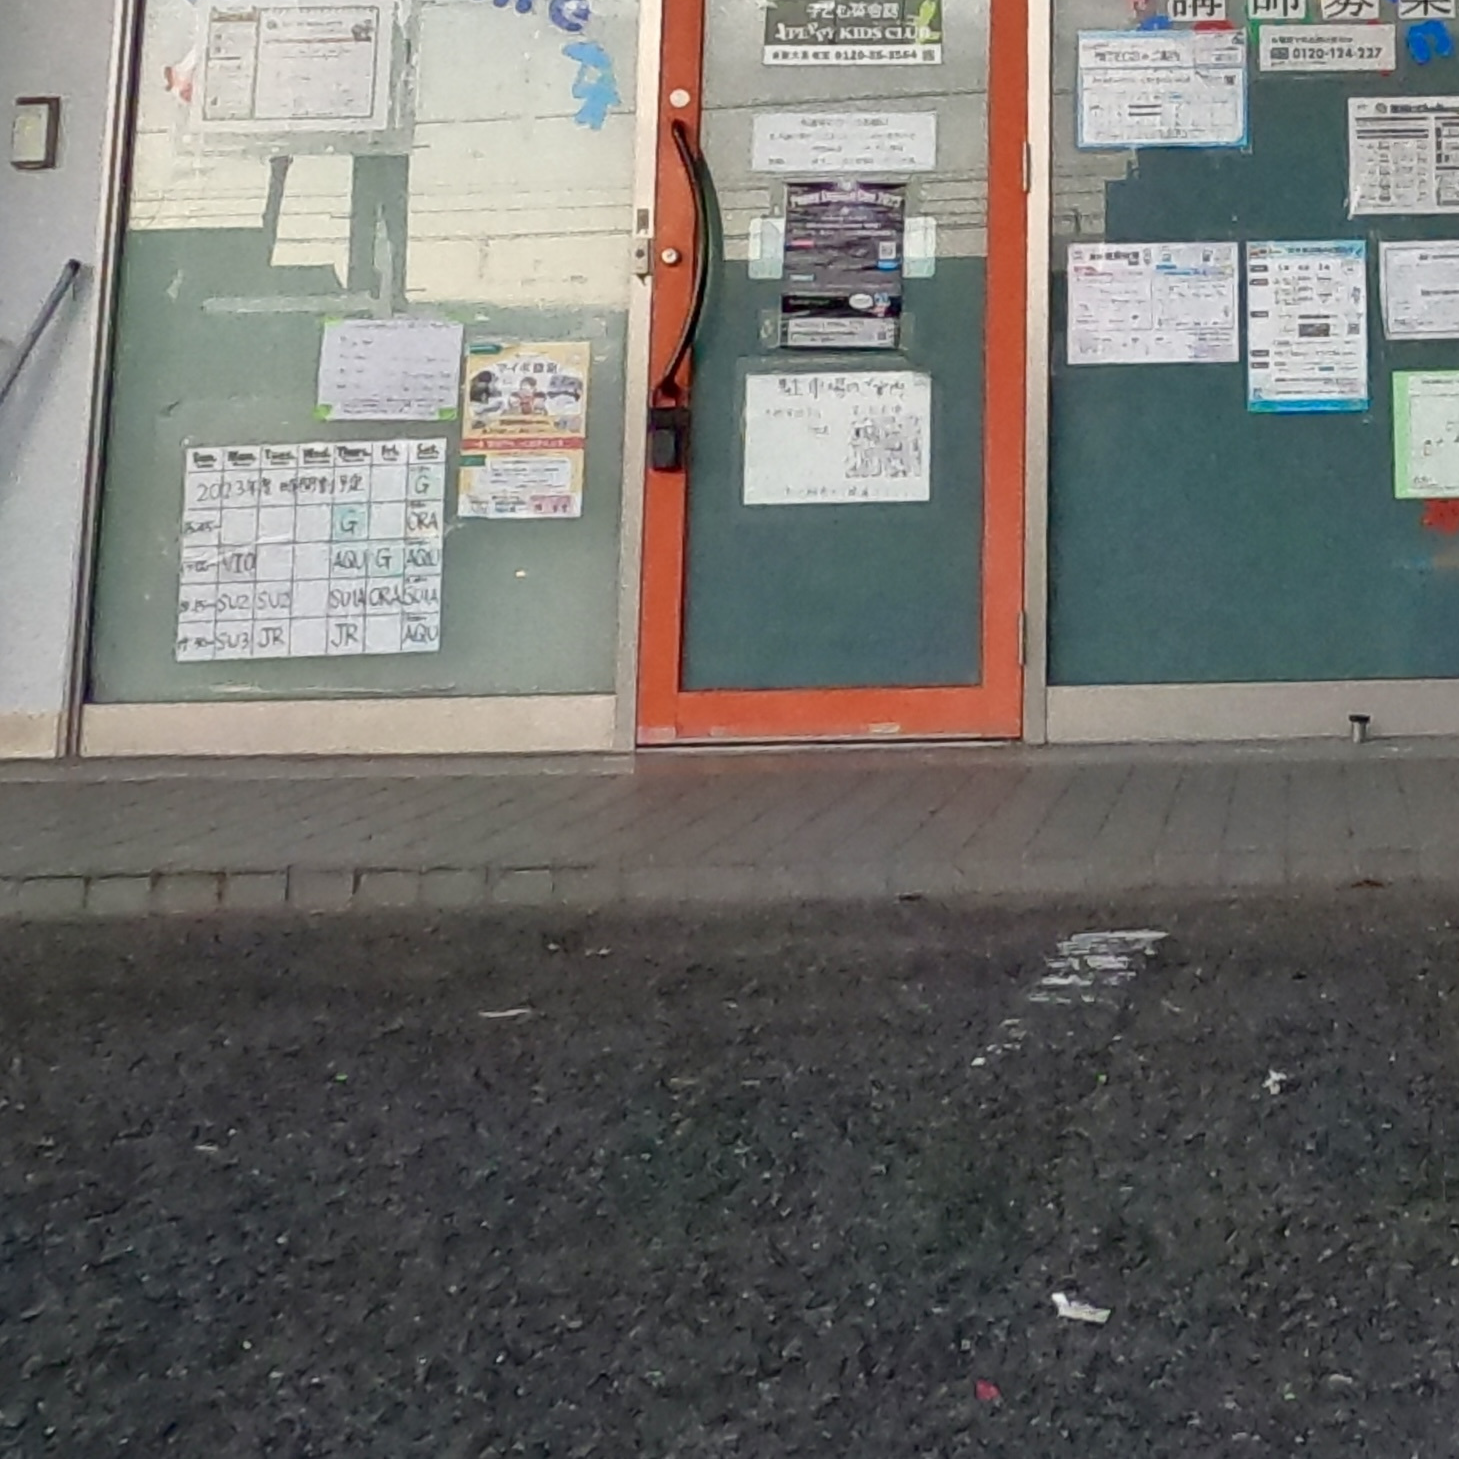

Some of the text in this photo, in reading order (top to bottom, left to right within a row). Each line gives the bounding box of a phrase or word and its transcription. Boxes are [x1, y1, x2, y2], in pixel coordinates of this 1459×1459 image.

[839, 26, 883, 40] KIDS
[1292, 47, 1383, 59] 0120-124-227
[375, 547, 392, 570] G
